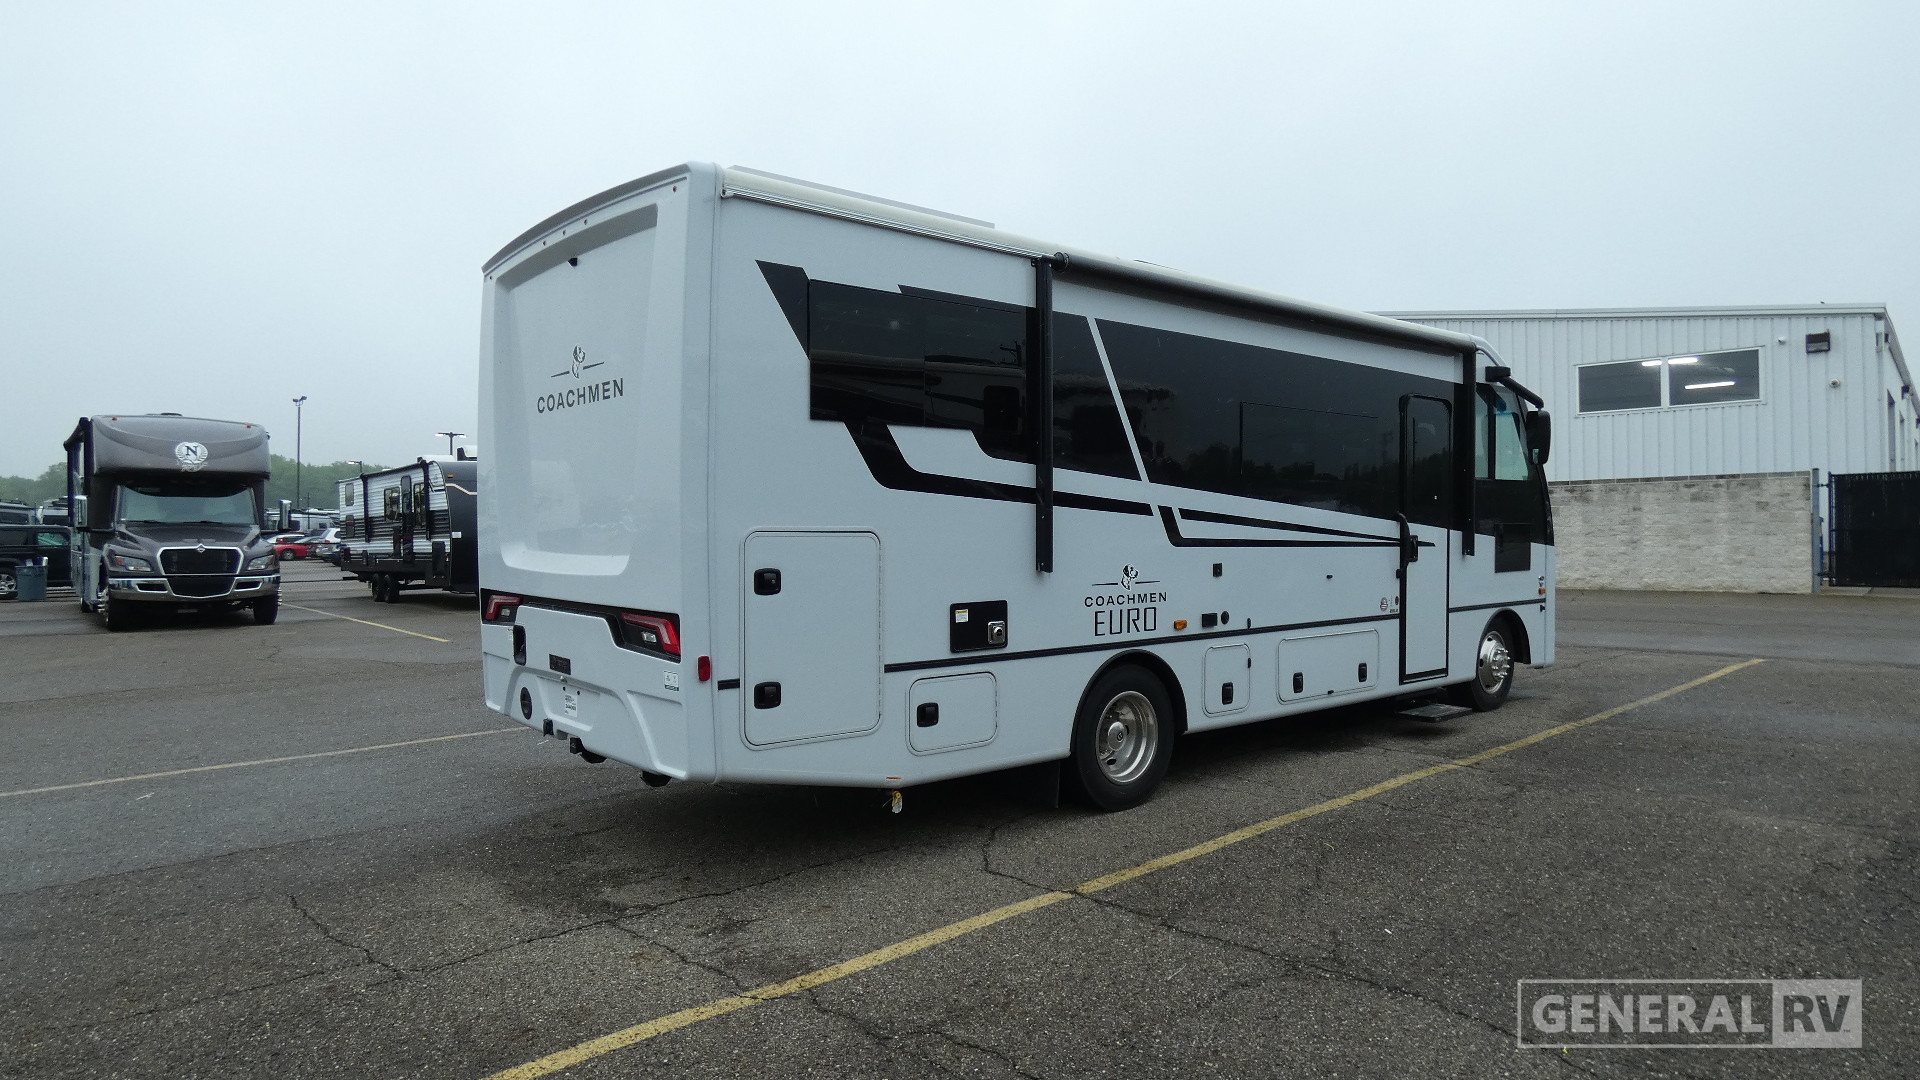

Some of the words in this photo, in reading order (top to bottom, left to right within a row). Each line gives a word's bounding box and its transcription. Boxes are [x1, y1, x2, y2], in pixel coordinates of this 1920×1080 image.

[537, 377, 624, 414] COACHMEN
[185, 445, 198, 456] N
[1084, 591, 1168, 608] COACHMEN
[1094, 606, 1157, 637] EURO
